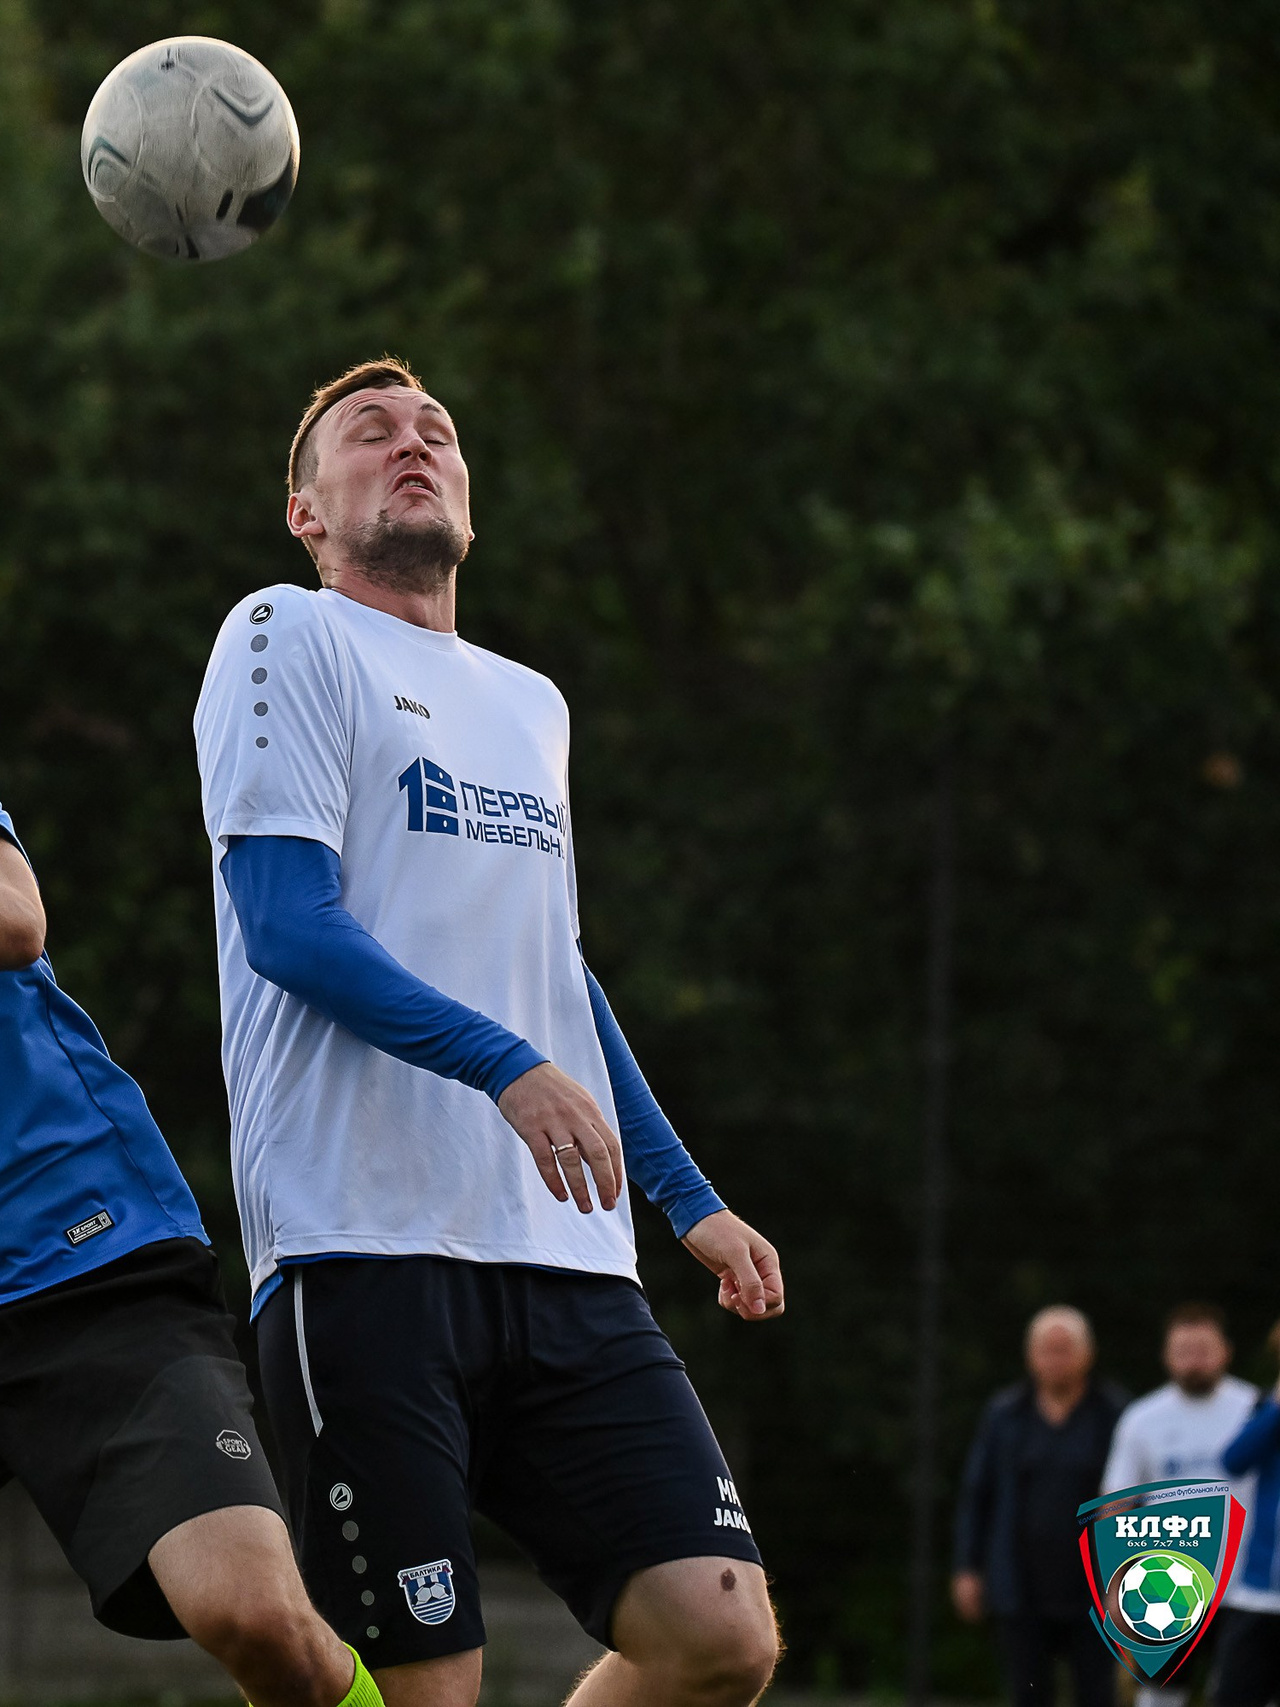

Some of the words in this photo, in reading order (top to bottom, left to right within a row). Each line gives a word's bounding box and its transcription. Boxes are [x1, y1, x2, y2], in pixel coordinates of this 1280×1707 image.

[394, 695, 431, 719] JAKO
[465, 819, 565, 859] МЕБЕЛЬН
[410, 1565, 441, 1578] БАЛТИКА
